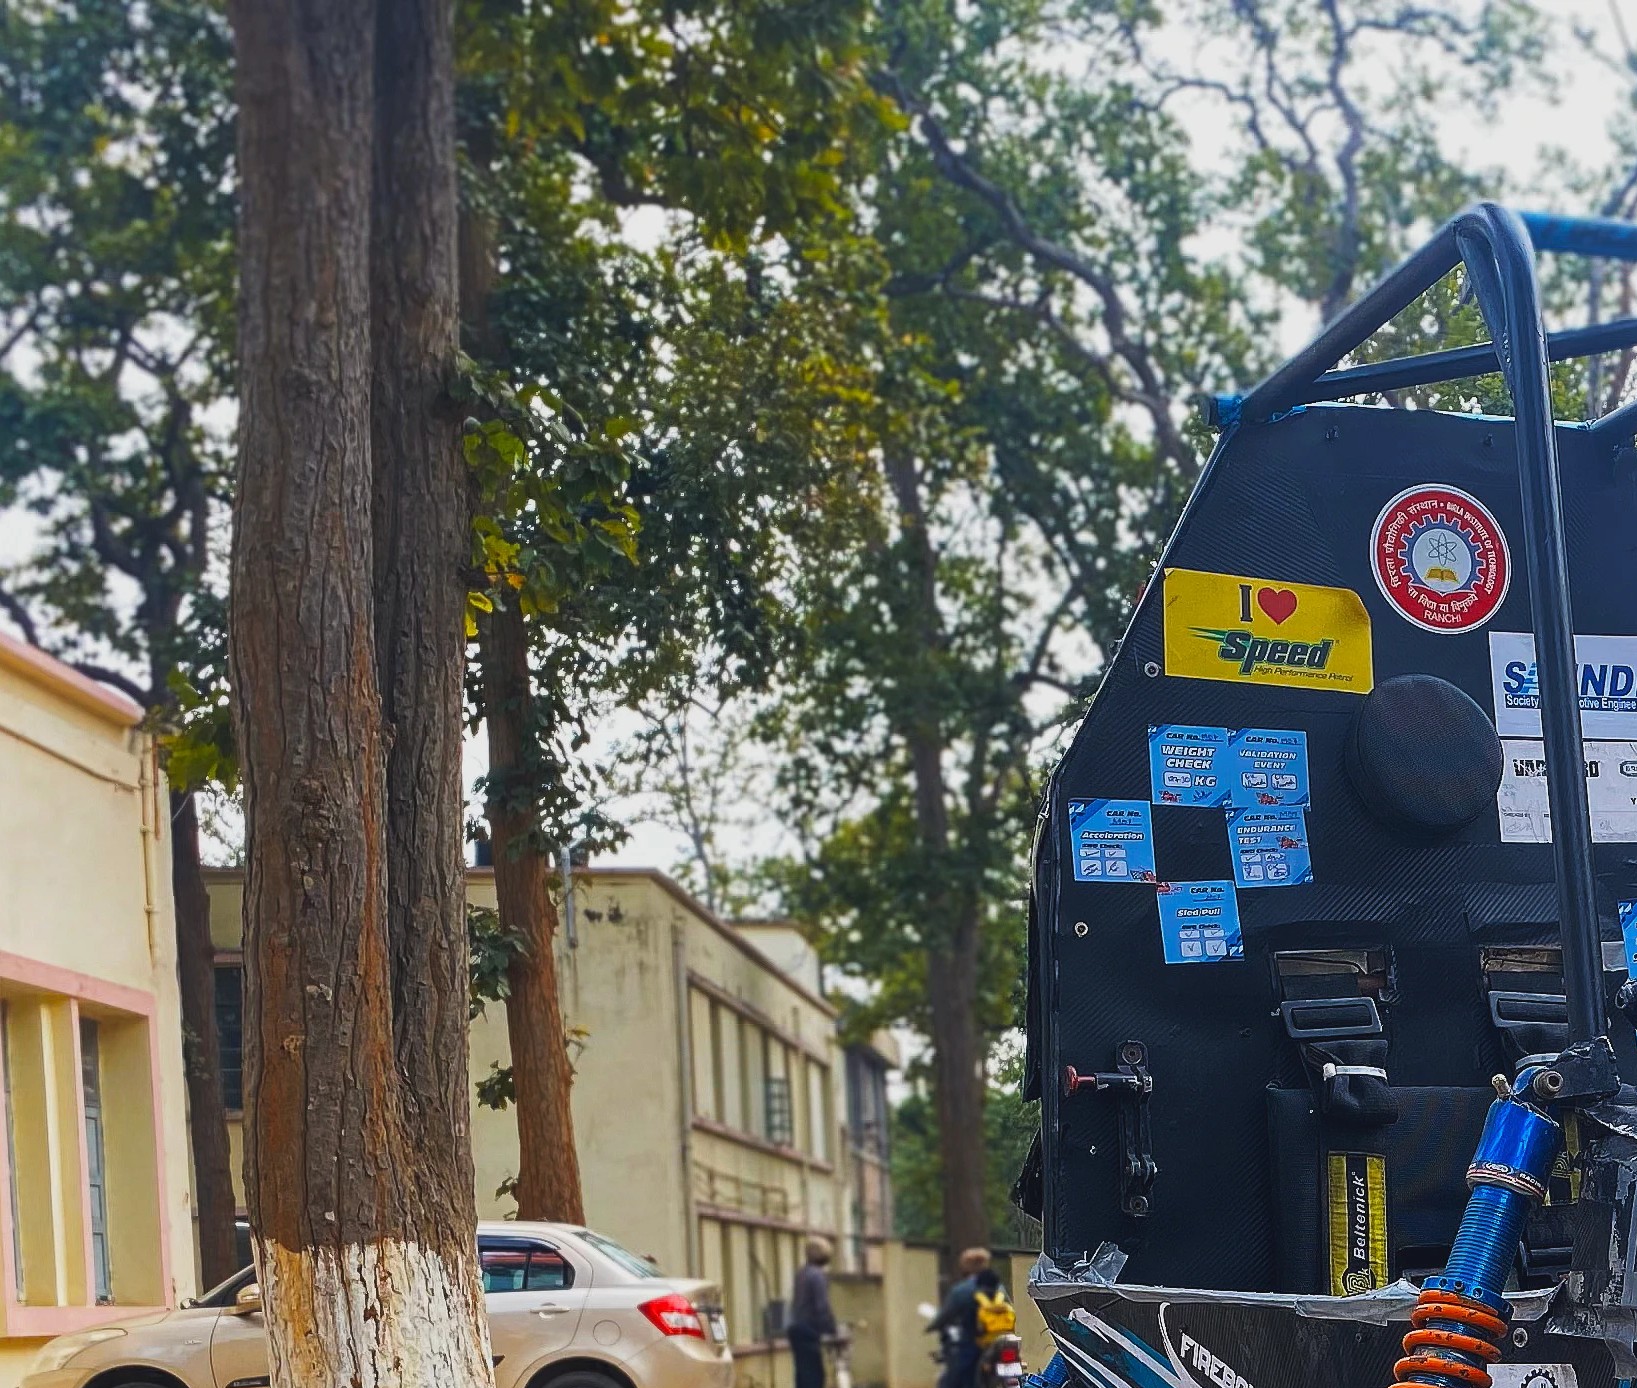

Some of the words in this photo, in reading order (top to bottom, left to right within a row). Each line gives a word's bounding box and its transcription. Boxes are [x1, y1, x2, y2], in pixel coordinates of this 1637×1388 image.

[1239, 584, 1253, 622] I
[1424, 610, 1462, 623] RANCHI
[1219, 630, 1334, 675] Speed
[1254, 665, 1273, 675] High
[1274, 667, 1328, 680] Performance
[1328, 672, 1353, 682] Petrol
[1506, 695, 1539, 708] Society
[1162, 745, 1215, 757] WEIGHT
[1239, 749, 1297, 760] VALIDATION
[1166, 758, 1212, 770] CHECK
[1254, 761, 1286, 769] EVENT
[1194, 776, 1217, 787] KG
[1081, 831, 1145, 840] Acceleration
[1238, 825, 1296, 834] ENDURANCE
[1239, 837, 1262, 845] TEST
[1177, 909, 1199, 918] Sled
[1200, 907, 1221, 916] Pull
[1353, 1175, 1366, 1260] Beltenick
